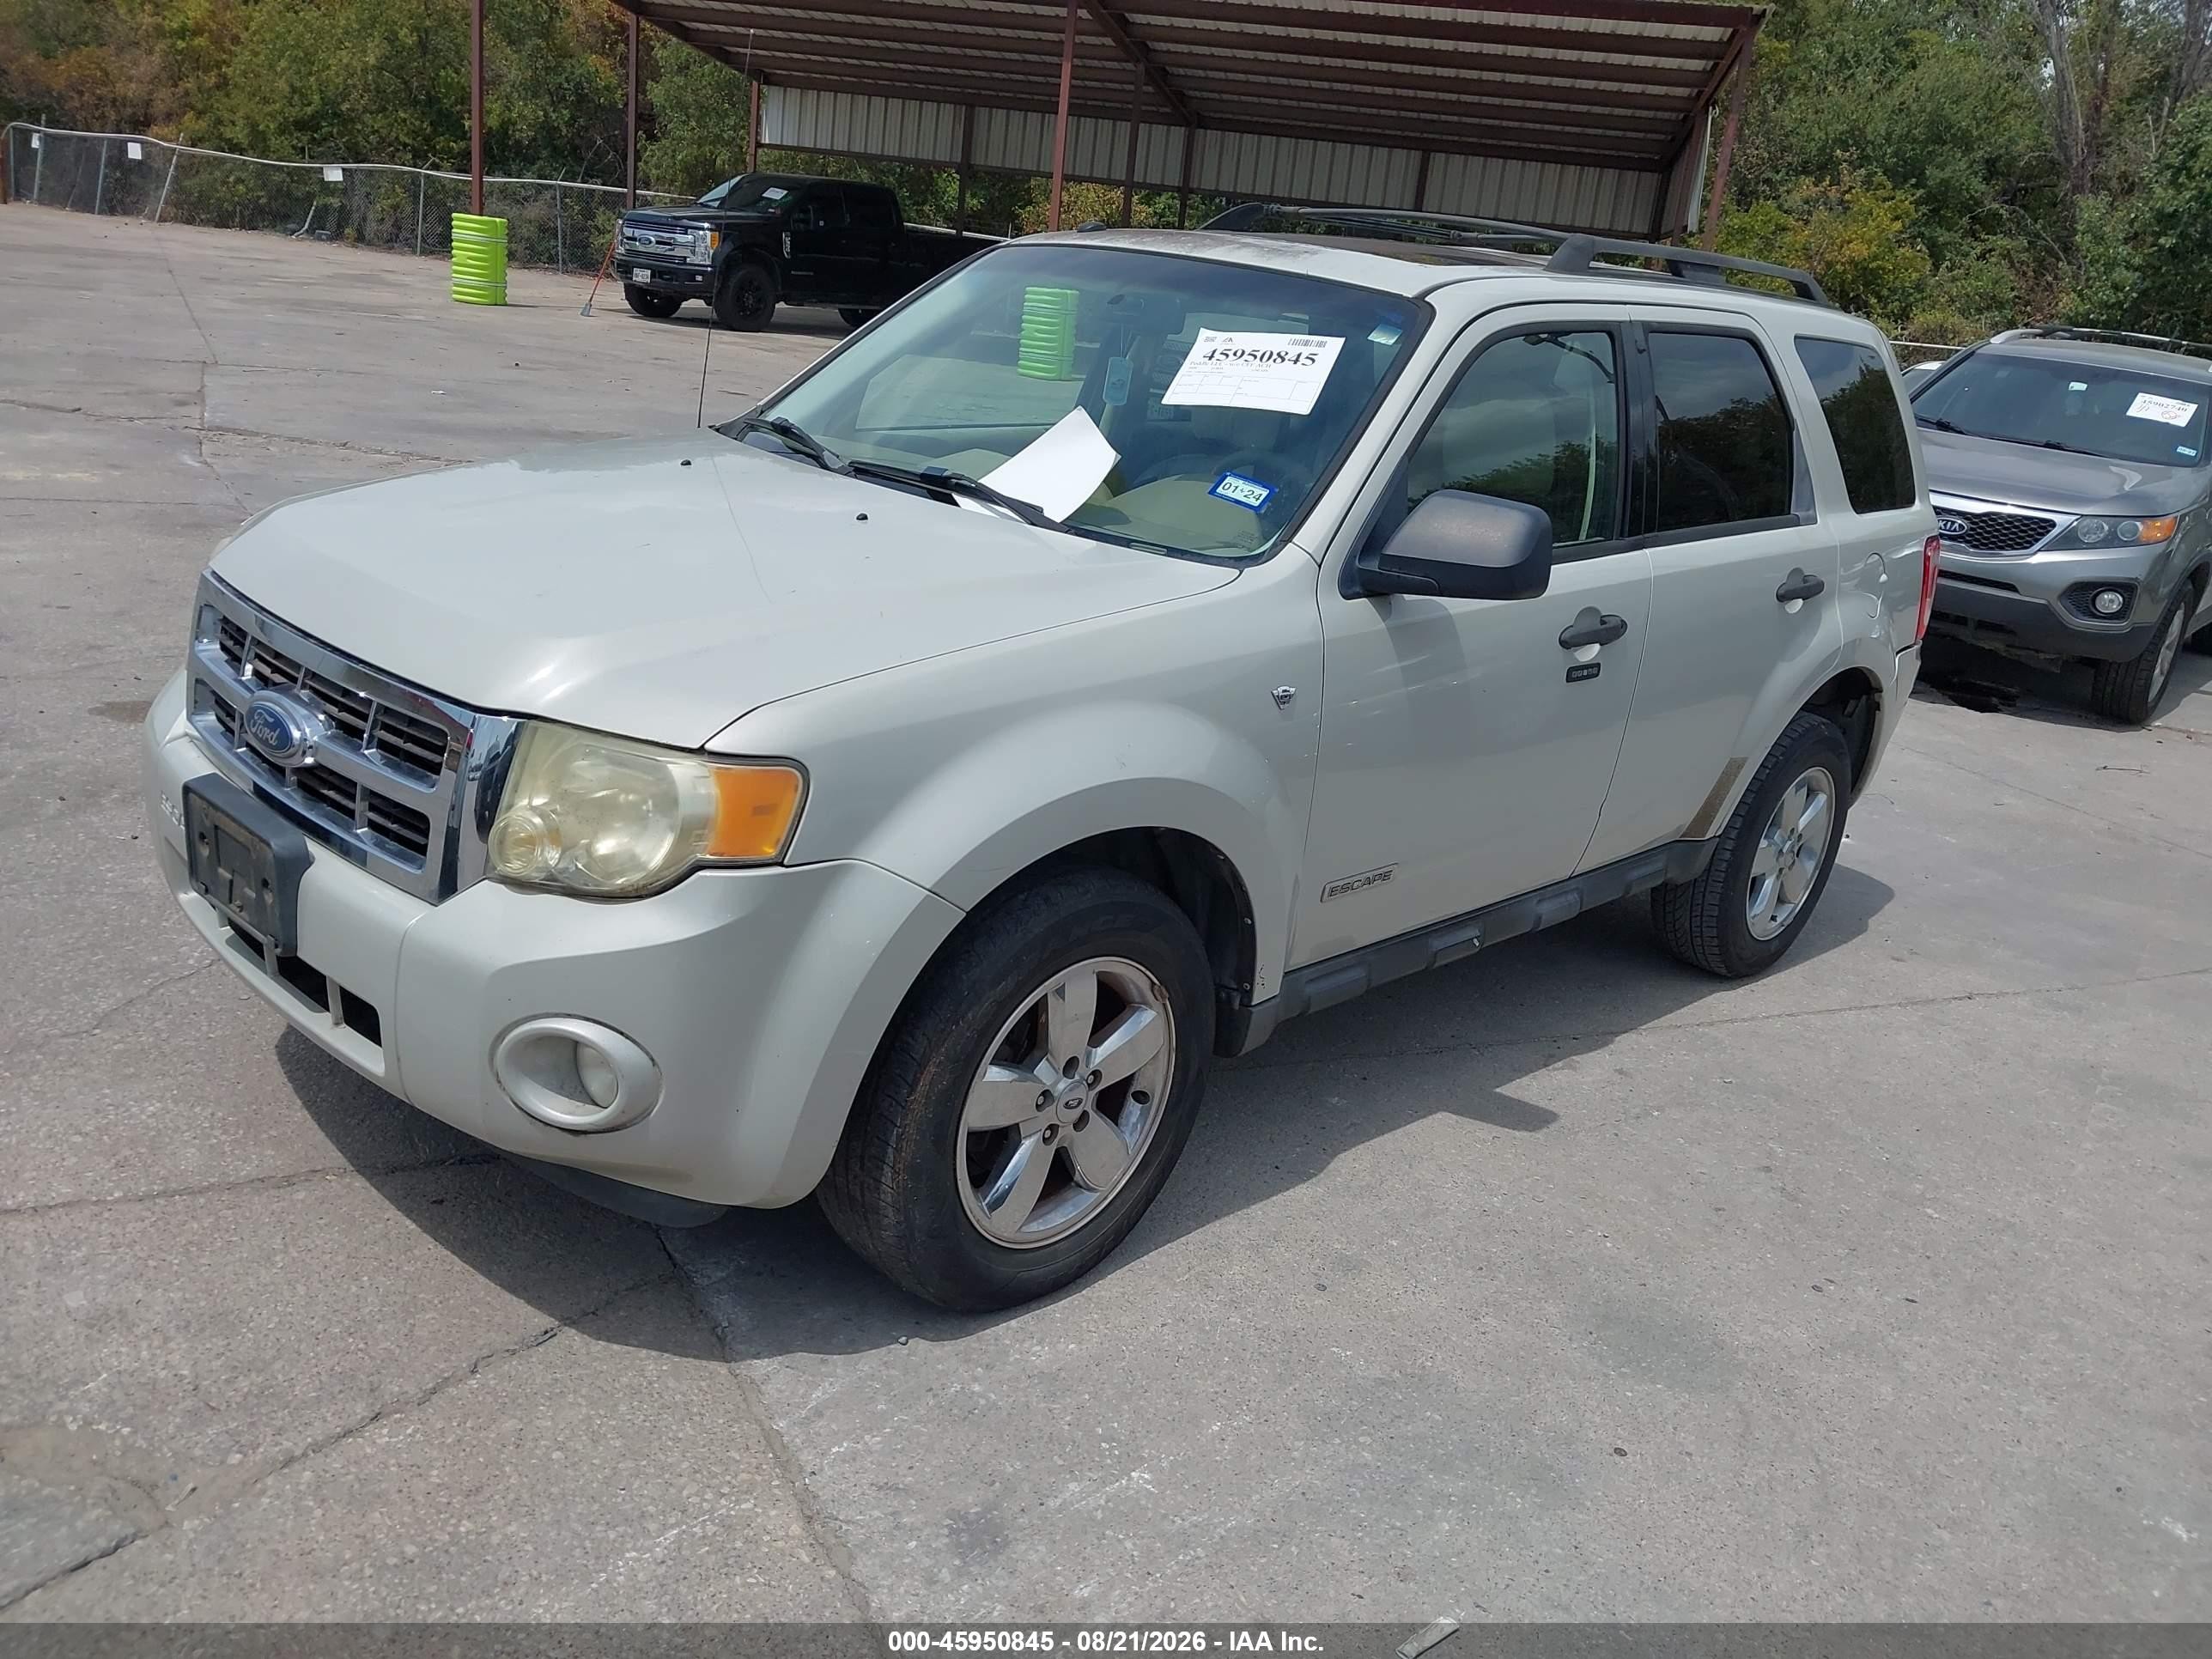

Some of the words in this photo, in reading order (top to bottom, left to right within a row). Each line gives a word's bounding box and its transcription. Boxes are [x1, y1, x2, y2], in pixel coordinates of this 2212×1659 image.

[1201, 348, 1320, 367] 45950845
[1221, 482, 1240, 494] 01
[1243, 489, 1263, 502] 24
[1938, 520, 1960, 532] KIA
[250, 709, 281, 746] Ford
[1327, 869, 1394, 898] ESCAPE
